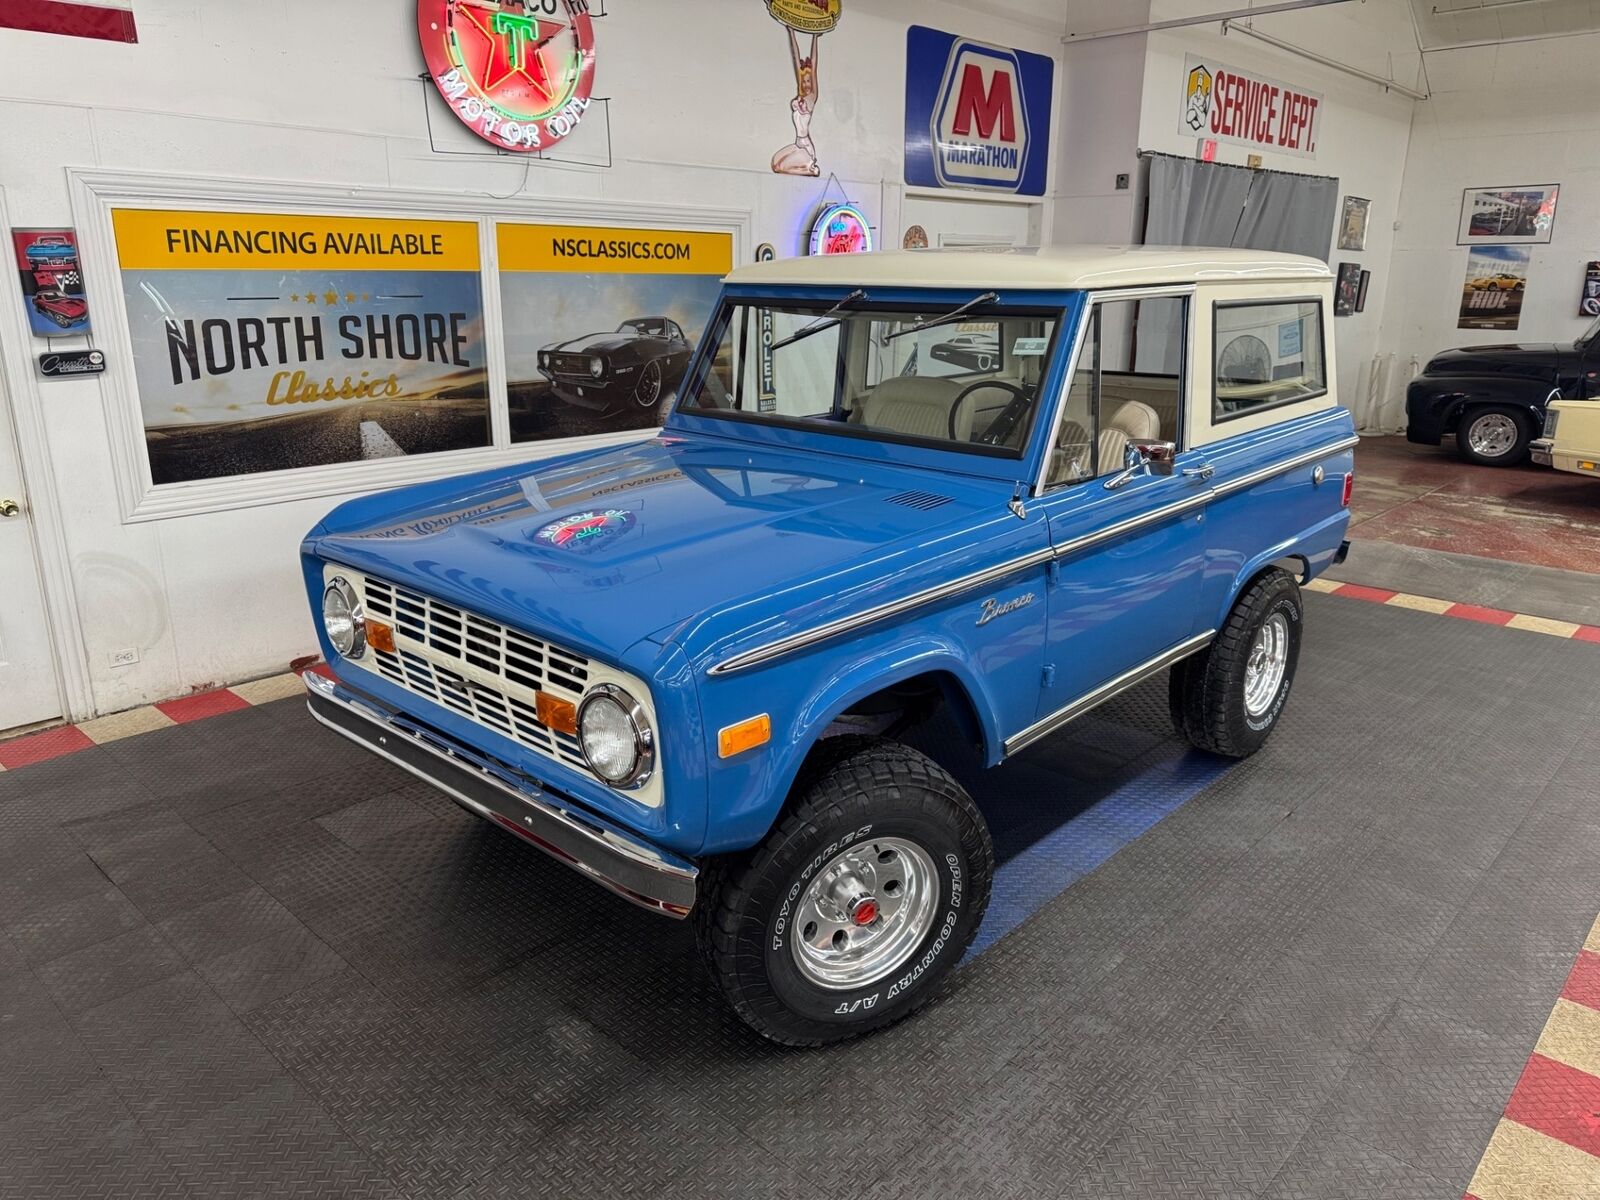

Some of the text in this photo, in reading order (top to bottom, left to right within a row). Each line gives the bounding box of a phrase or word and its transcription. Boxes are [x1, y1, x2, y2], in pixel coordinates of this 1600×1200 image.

[437, 69, 541, 147] MOTOR
[545, 96, 590, 138] OIL
[952, 63, 1016, 143] M
[1210, 70, 1318, 152] SERVICE DEPT.
[947, 141, 1018, 169] MARATHON
[166, 228, 444, 256] FINANCING AVAILABLE
[552, 238, 690, 260] NSCLASSICS.COM
[1468, 290, 1509, 309] RIDE
[166, 312, 471, 386] NORTH SHORE
[265, 370, 403, 407] Classics
[975, 592, 1035, 625] Bronco
[773, 825, 873, 950] TOYO TIRES
[835, 854, 962, 1015] OPEN COUNTRY A/T
